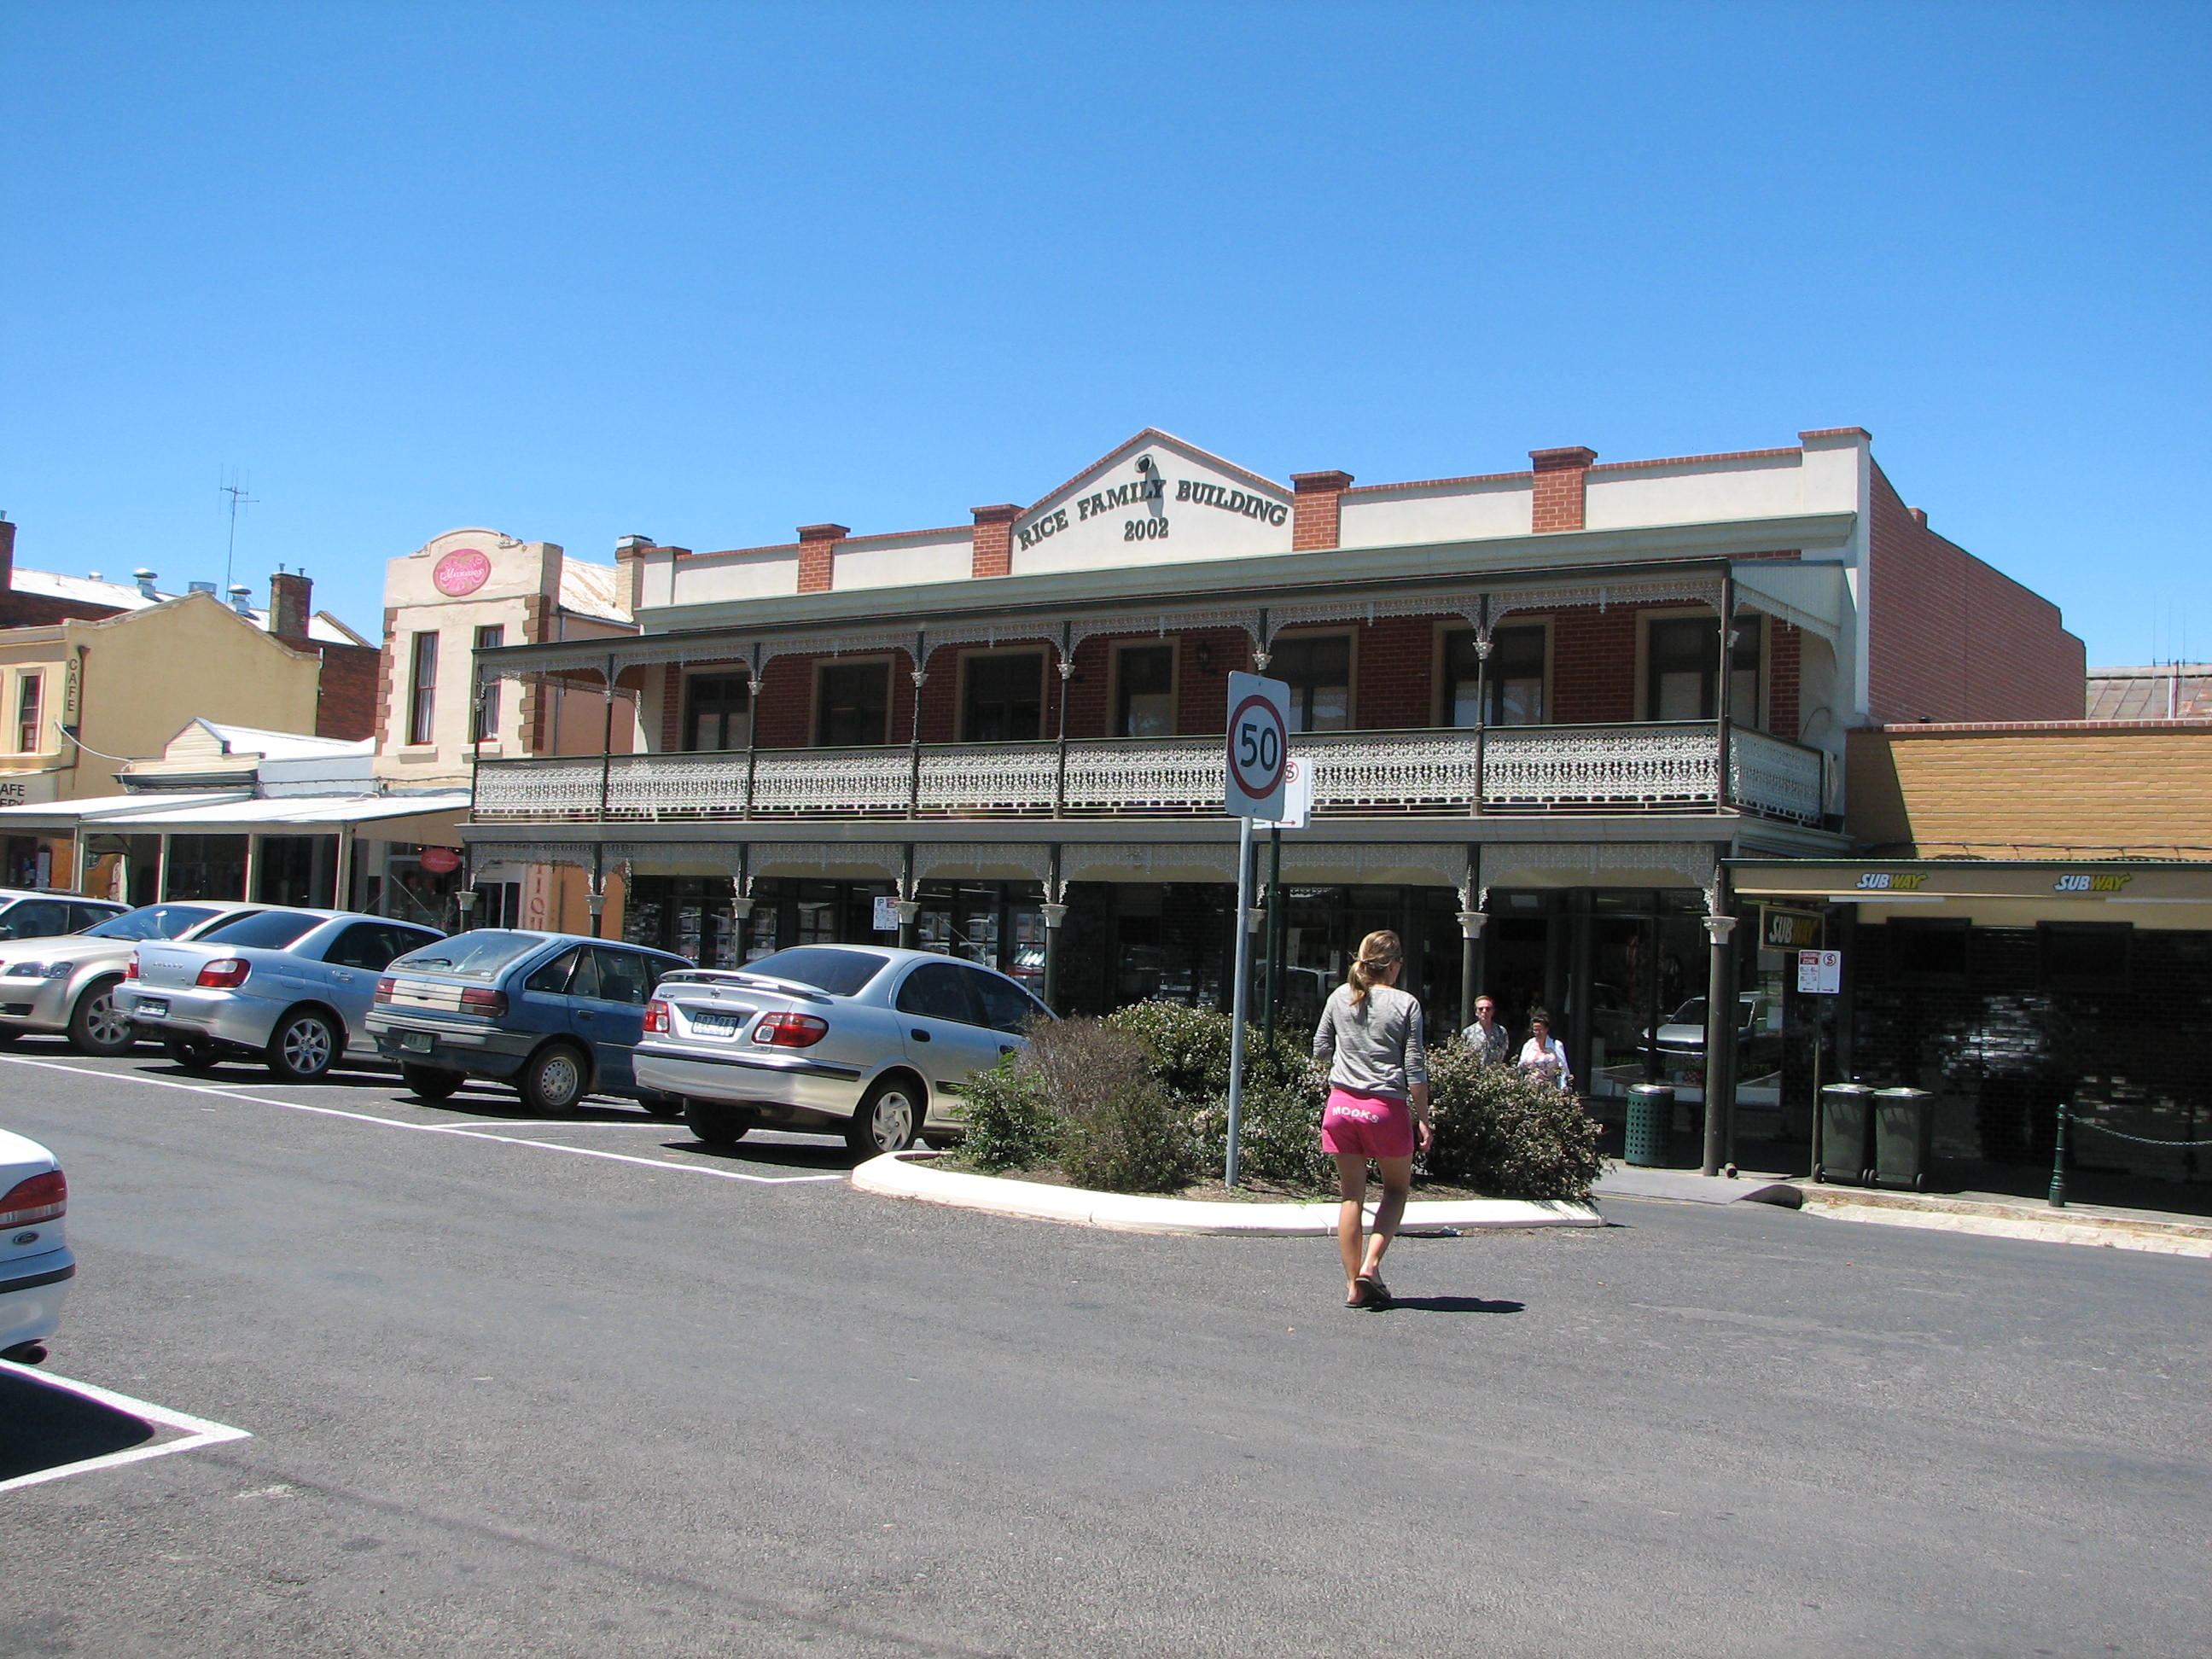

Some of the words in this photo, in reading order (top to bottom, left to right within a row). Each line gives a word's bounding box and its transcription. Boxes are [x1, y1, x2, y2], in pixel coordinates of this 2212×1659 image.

[1017, 508, 1068, 551] RICE
[1077, 479, 1167, 521] FAMILY
[1175, 479, 1288, 527] BUILDING
[1124, 516, 1169, 542] 2002
[67, 658, 78, 712] CAFE
[1240, 723, 1278, 771] 50
[1855, 873, 1928, 890] SUBWAY
[2054, 873, 2131, 892] SUBWAY
[1769, 915, 1818, 945] SUBWAY
